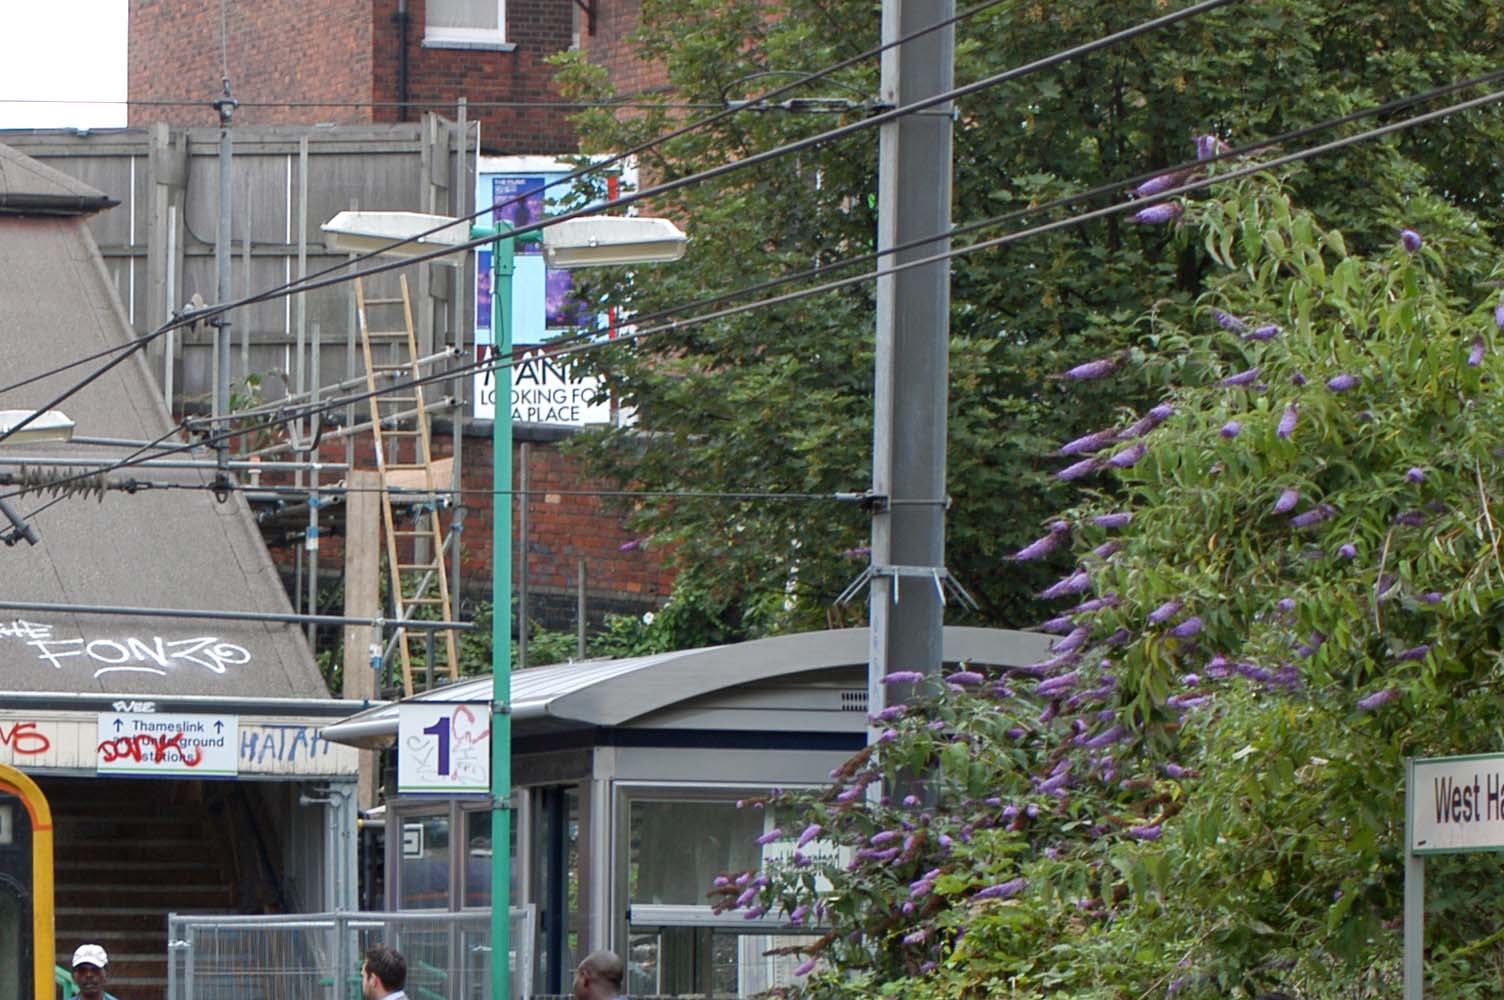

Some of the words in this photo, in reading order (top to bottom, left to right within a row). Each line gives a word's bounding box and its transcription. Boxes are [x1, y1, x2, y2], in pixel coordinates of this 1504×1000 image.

[512, 407, 523, 419] A
[528, 406, 580, 421] PLACE
[132, 720, 204, 732] Thameslink
[423, 717, 451, 776] 1
[1434, 775, 1481, 824] West
